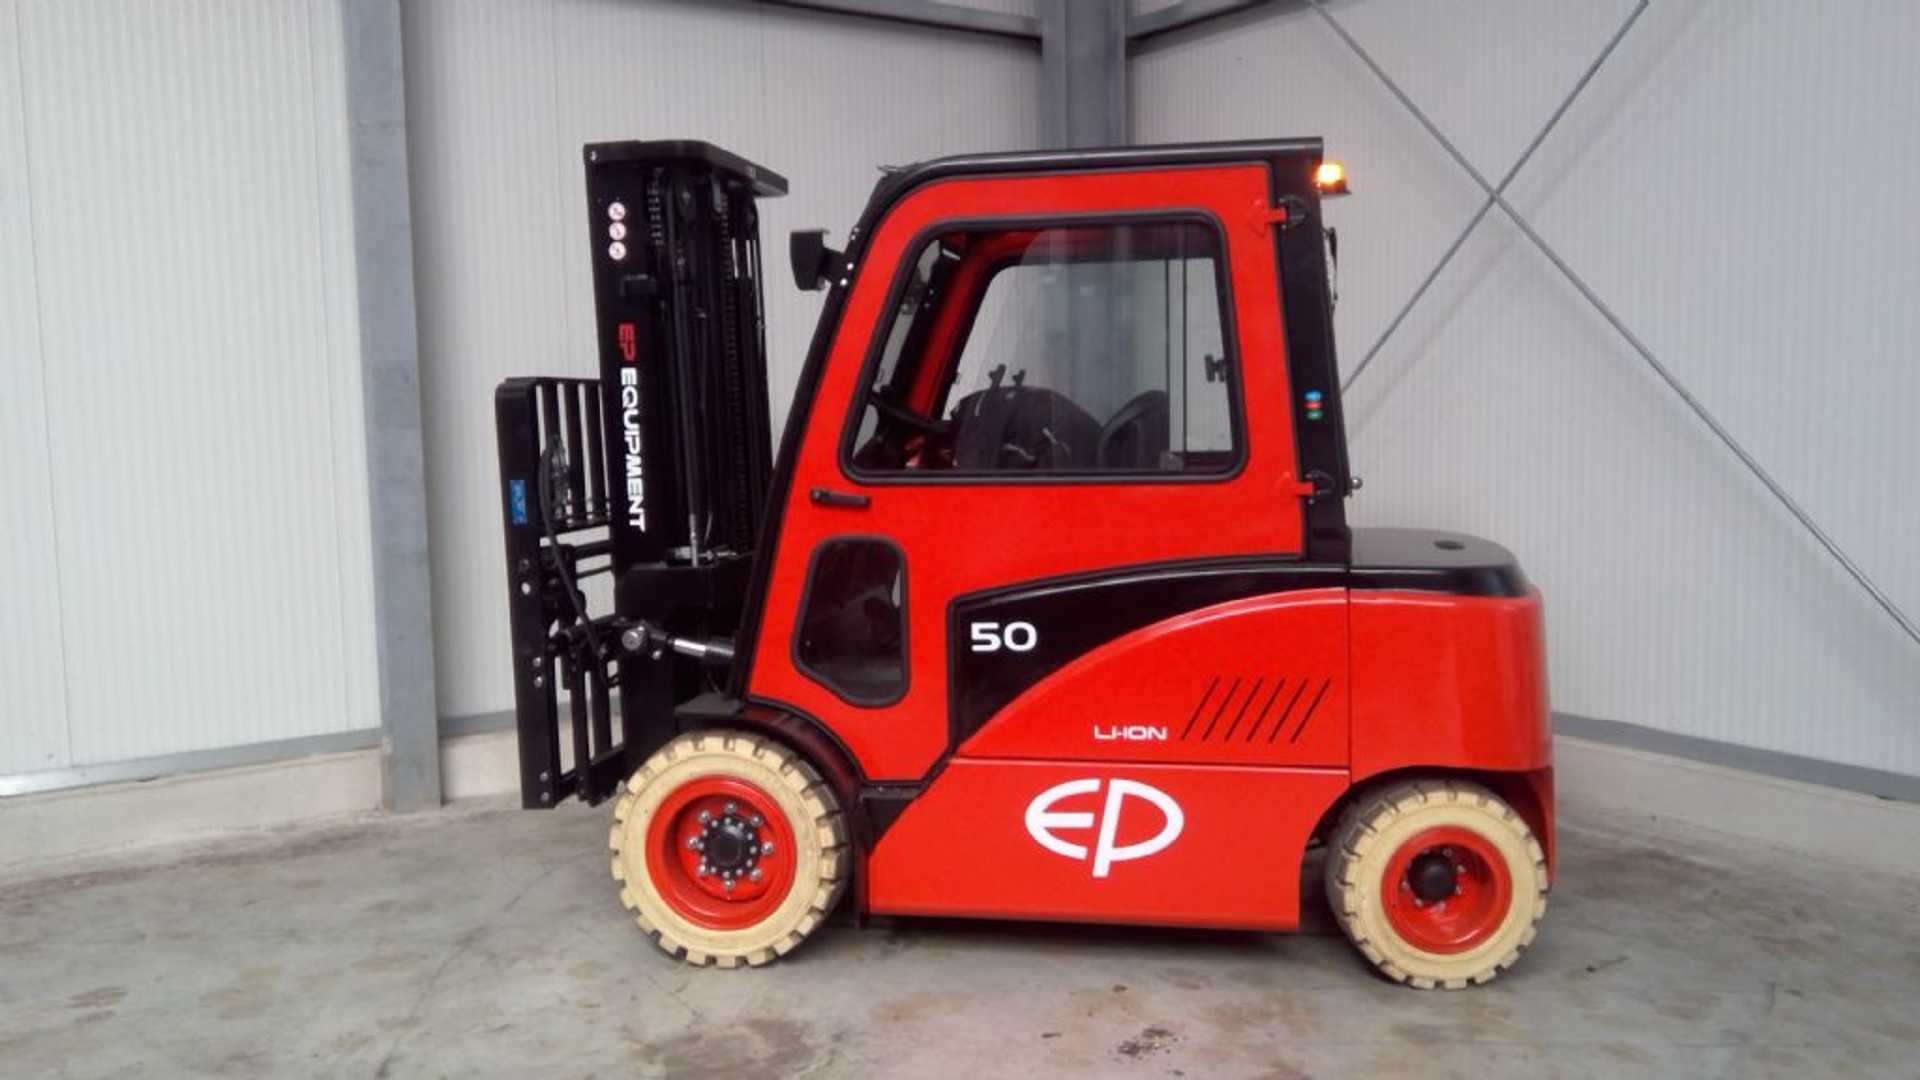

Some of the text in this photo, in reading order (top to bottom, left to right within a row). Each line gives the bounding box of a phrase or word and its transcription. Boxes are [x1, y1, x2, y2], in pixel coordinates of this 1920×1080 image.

[619, 323, 645, 531] EP EQUIPMENT
[970, 621, 1037, 652] 50
[1025, 778, 1184, 877] EP
